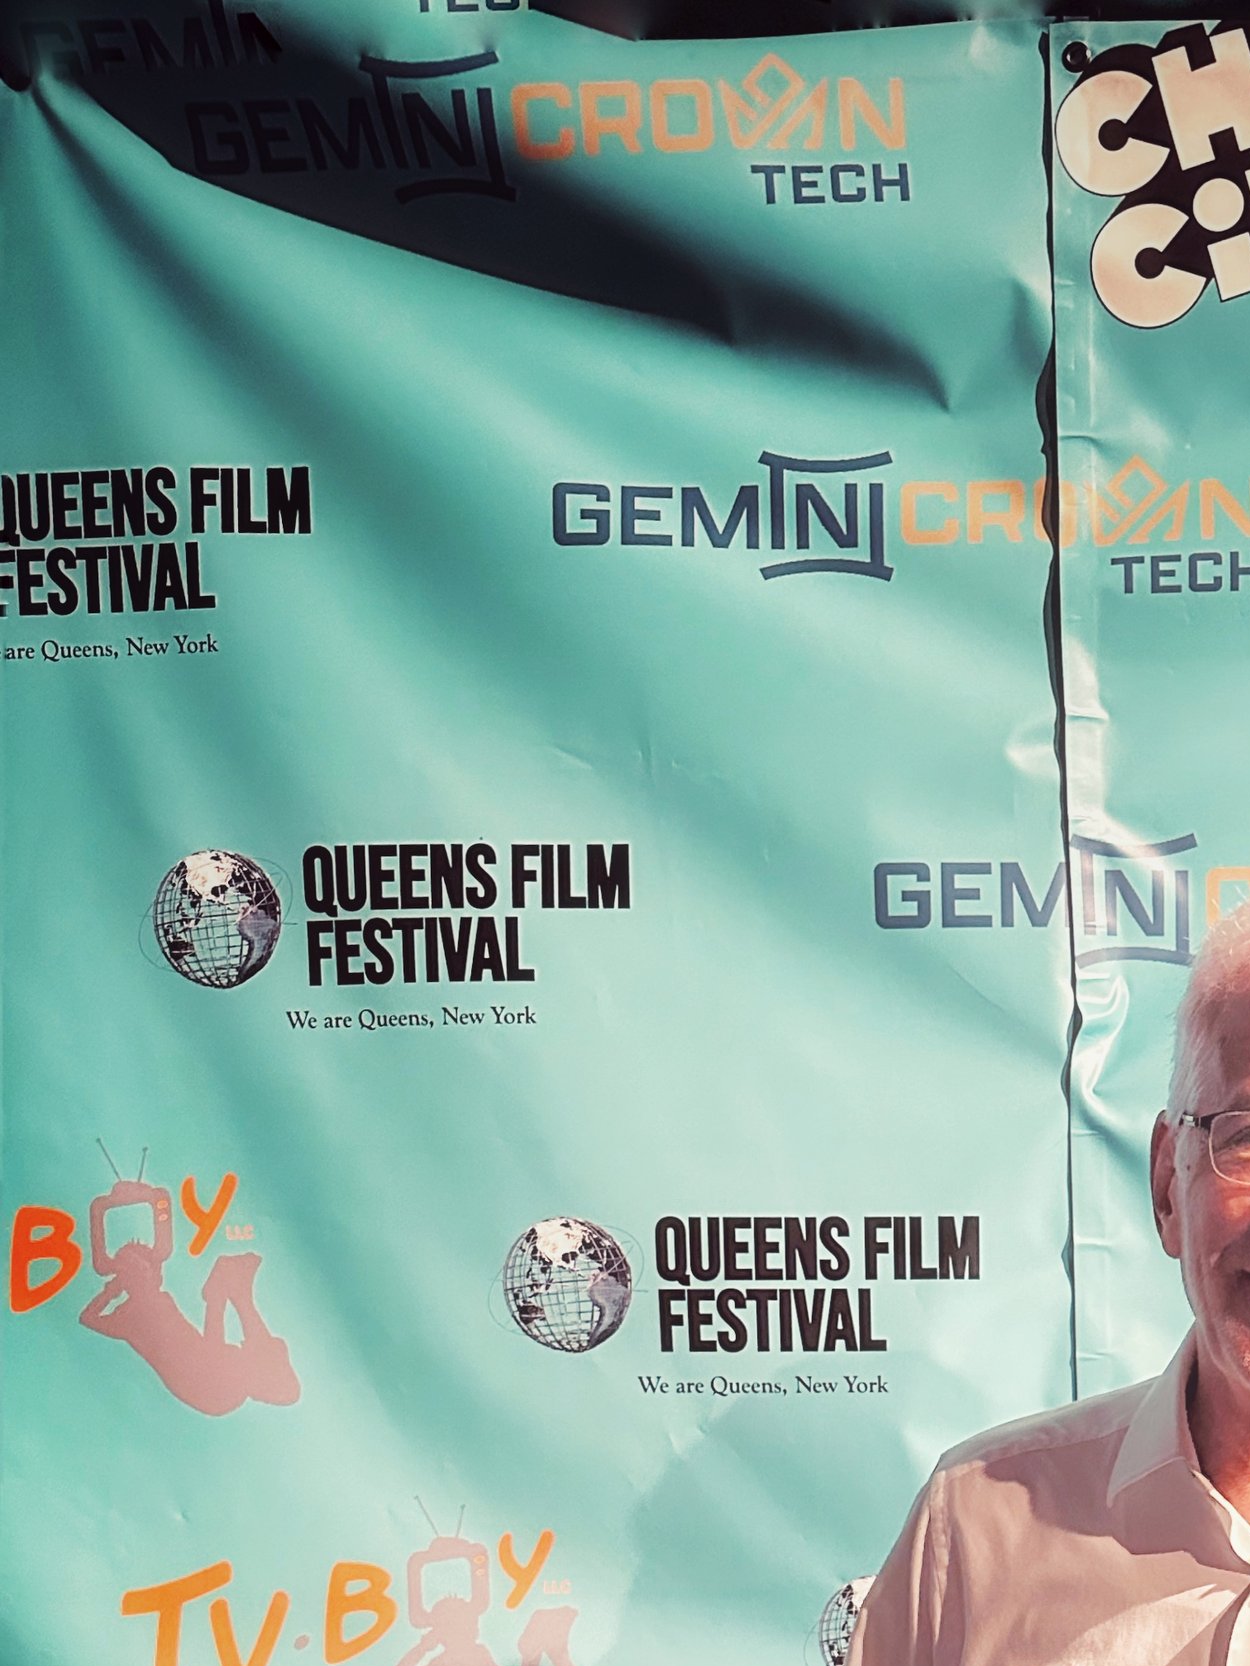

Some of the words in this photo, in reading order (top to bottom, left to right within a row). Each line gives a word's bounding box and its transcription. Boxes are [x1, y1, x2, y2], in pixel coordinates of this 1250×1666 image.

[510, 52, 906, 160] CROWN
[750, 162, 912, 204] TECH
[190, 466, 311, 534] FILM
[552, 451, 893, 581] GEMINI
[41, 640, 119, 662] Queens,
[126, 636, 169, 656] New
[173, 634, 218, 654] York
[303, 843, 498, 917] QUEENS
[511, 843, 630, 909] FILM
[873, 832, 1198, 968] GEMINI
[306, 916, 535, 986] FESTIVAL
[286, 1008, 319, 1030] We
[324, 1014, 352, 1028] are
[358, 1008, 434, 1031] Queens,
[442, 1007, 484, 1026] New
[490, 1005, 537, 1025] York
[655, 1216, 850, 1287] QUEENS
[864, 1216, 980, 1280] FILM
[658, 1288, 888, 1353] FESTIVAL
[638, 1376, 670, 1394] We
[676, 1381, 704, 1394] are
[711, 1376, 788, 1397] Queens,
[796, 1376, 838, 1394] New
[844, 1375, 888, 1394] York
